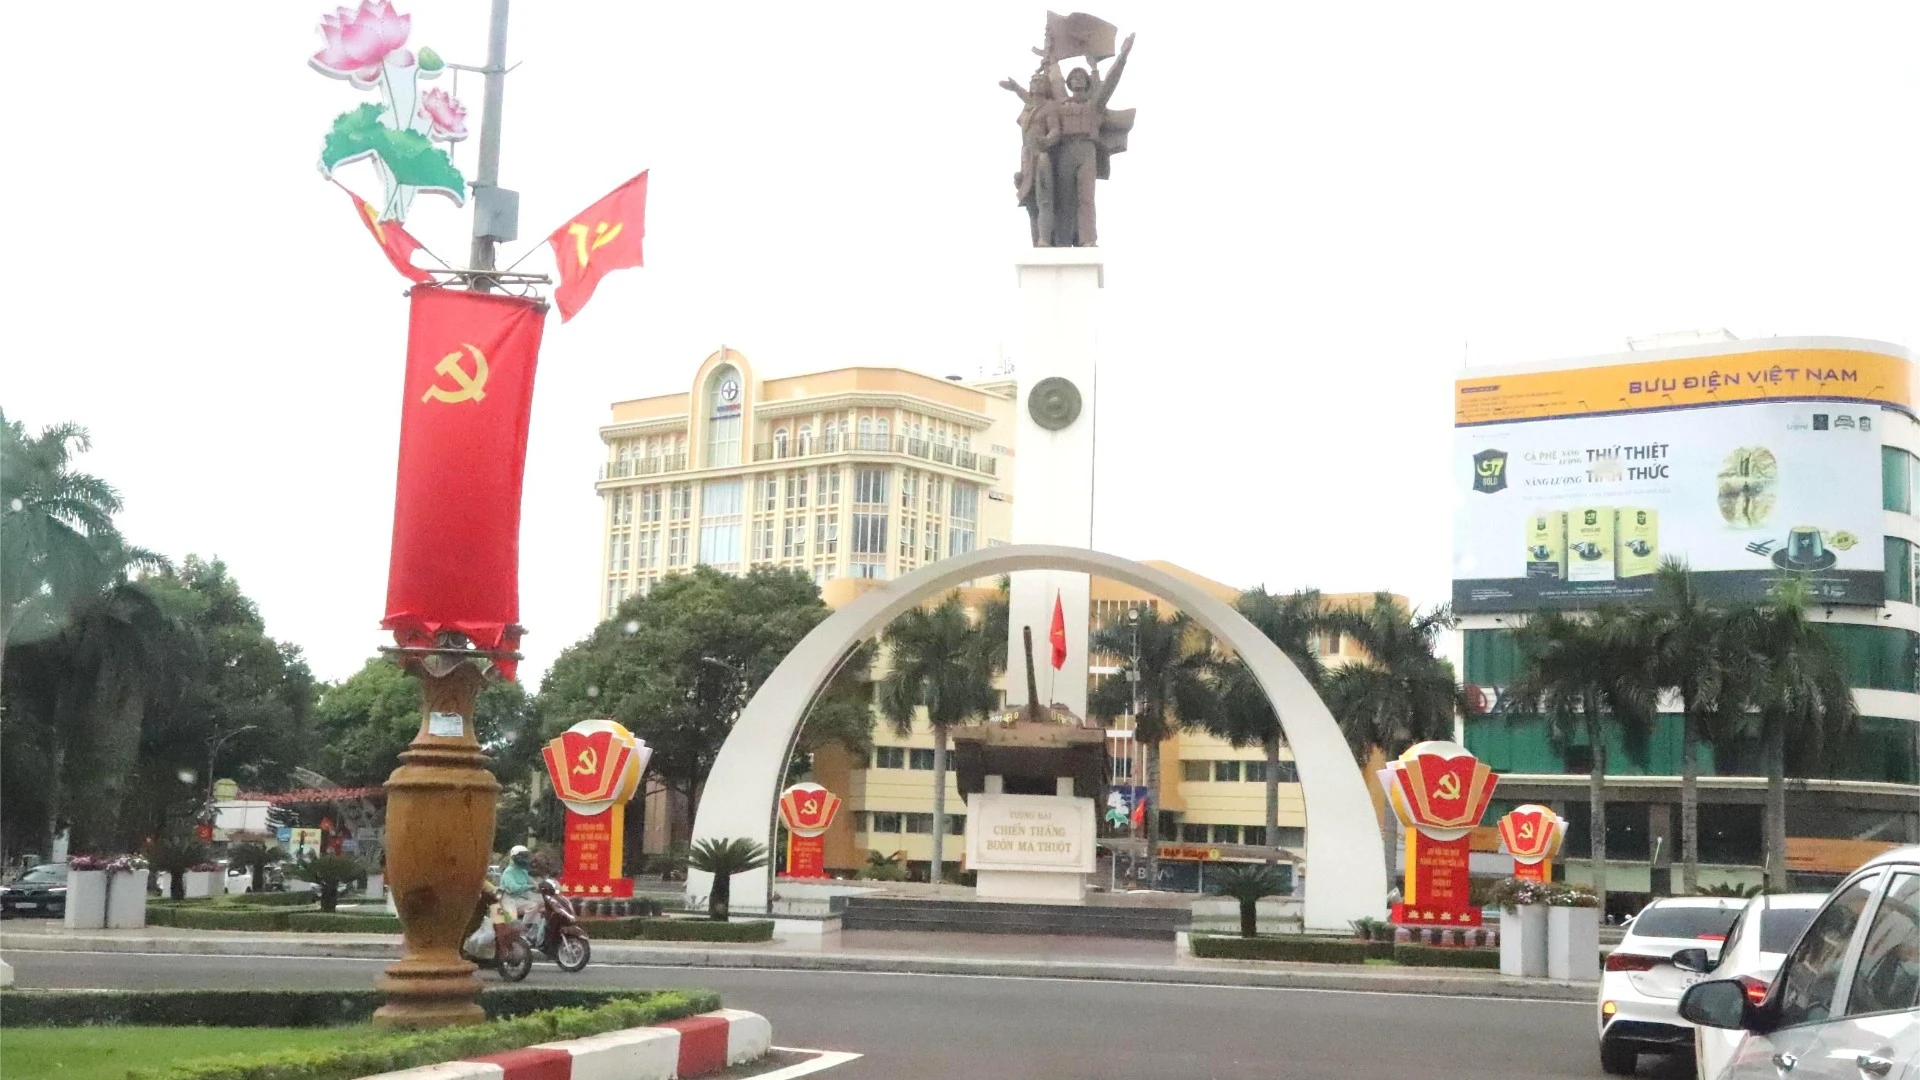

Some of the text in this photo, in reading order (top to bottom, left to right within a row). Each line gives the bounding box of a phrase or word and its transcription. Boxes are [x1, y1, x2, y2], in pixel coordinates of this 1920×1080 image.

[1629, 364, 1857, 394] BƯU ĐIỆN VIỆT NAM
[1586, 441, 1669, 462] THỨ THIỆT
[1476, 456, 1504, 477] G7
[1627, 463, 1669, 481] THỨC
[1018, 842, 1034, 852] MA
